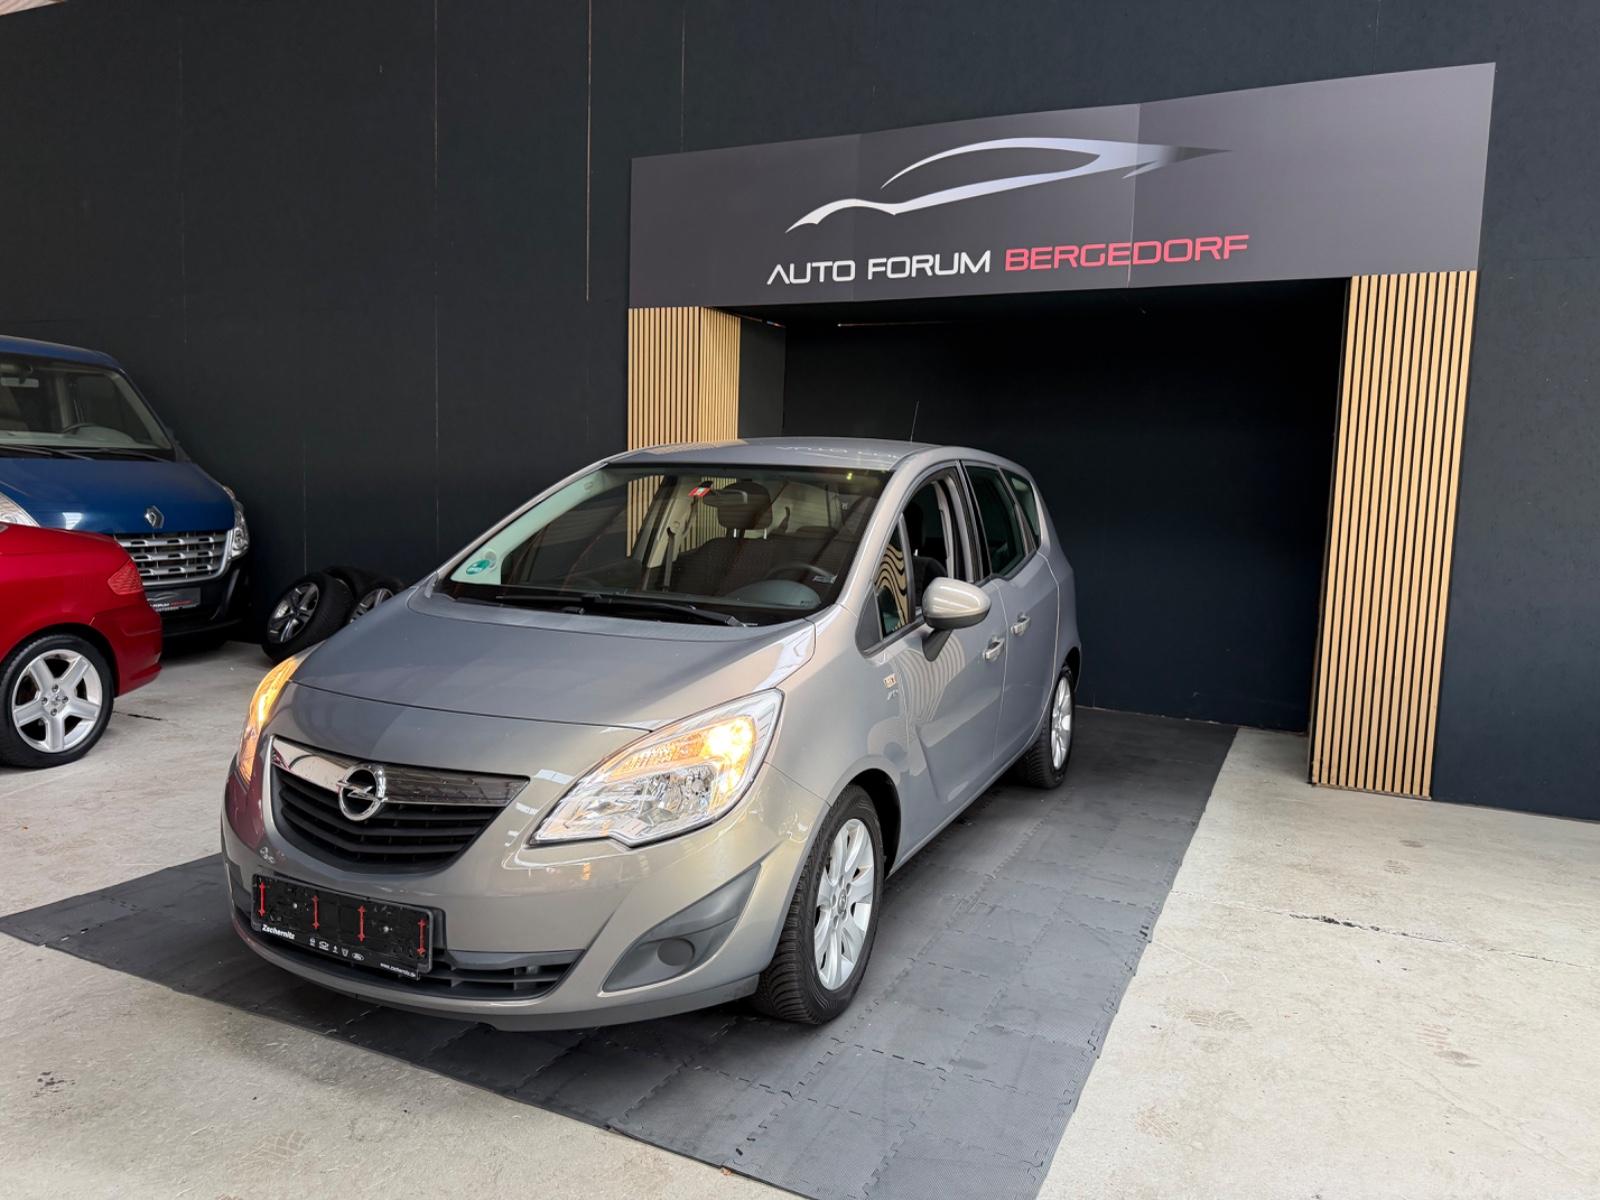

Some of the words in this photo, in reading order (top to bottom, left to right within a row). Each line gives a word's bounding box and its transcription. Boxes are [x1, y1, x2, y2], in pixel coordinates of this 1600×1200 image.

[767, 260, 856, 285] AUTO
[867, 250, 991, 280] FORUM
[1004, 235, 1249, 272] BERGEDORF
